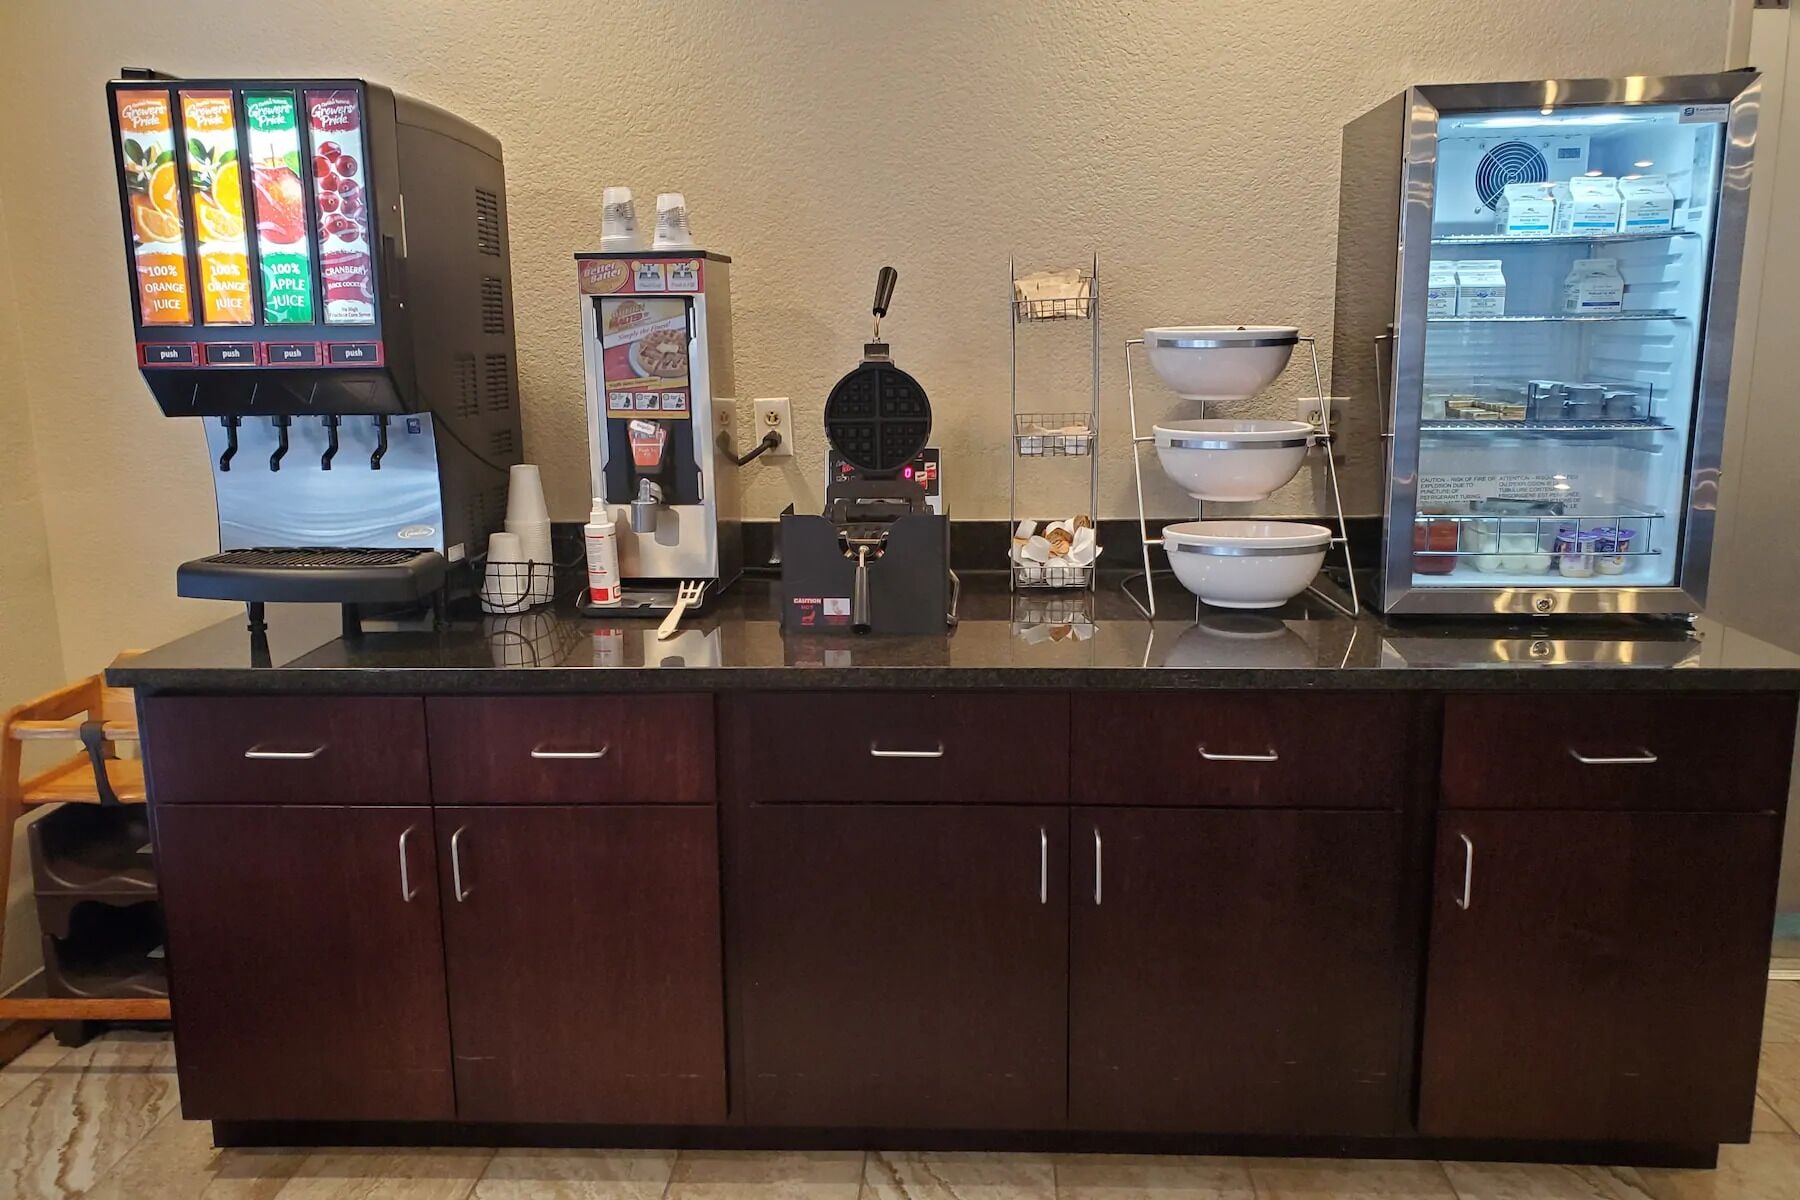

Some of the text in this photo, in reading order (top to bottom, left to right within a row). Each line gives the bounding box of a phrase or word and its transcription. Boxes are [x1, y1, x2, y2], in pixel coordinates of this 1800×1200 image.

[131, 114, 161, 128] Pride
[194, 114, 224, 128] Pride
[257, 114, 287, 128] Pride
[320, 113, 349, 128] Pride
[148, 264, 178, 277] 100%
[210, 263, 241, 276] 100%
[271, 262, 301, 275] 100%
[325, 265, 369, 276] CRANBERRY
[145, 281, 185, 294] ORANGE
[207, 280, 247, 293] ORANGE
[270, 278, 306, 291] APPLE
[153, 299, 181, 312] JUICE
[215, 298, 243, 311] JUICE
[272, 294, 305, 310] JUICE
[160, 349, 179, 360] push
[222, 349, 240, 359] push
[284, 349, 302, 359] push
[345, 348, 363, 358] push
